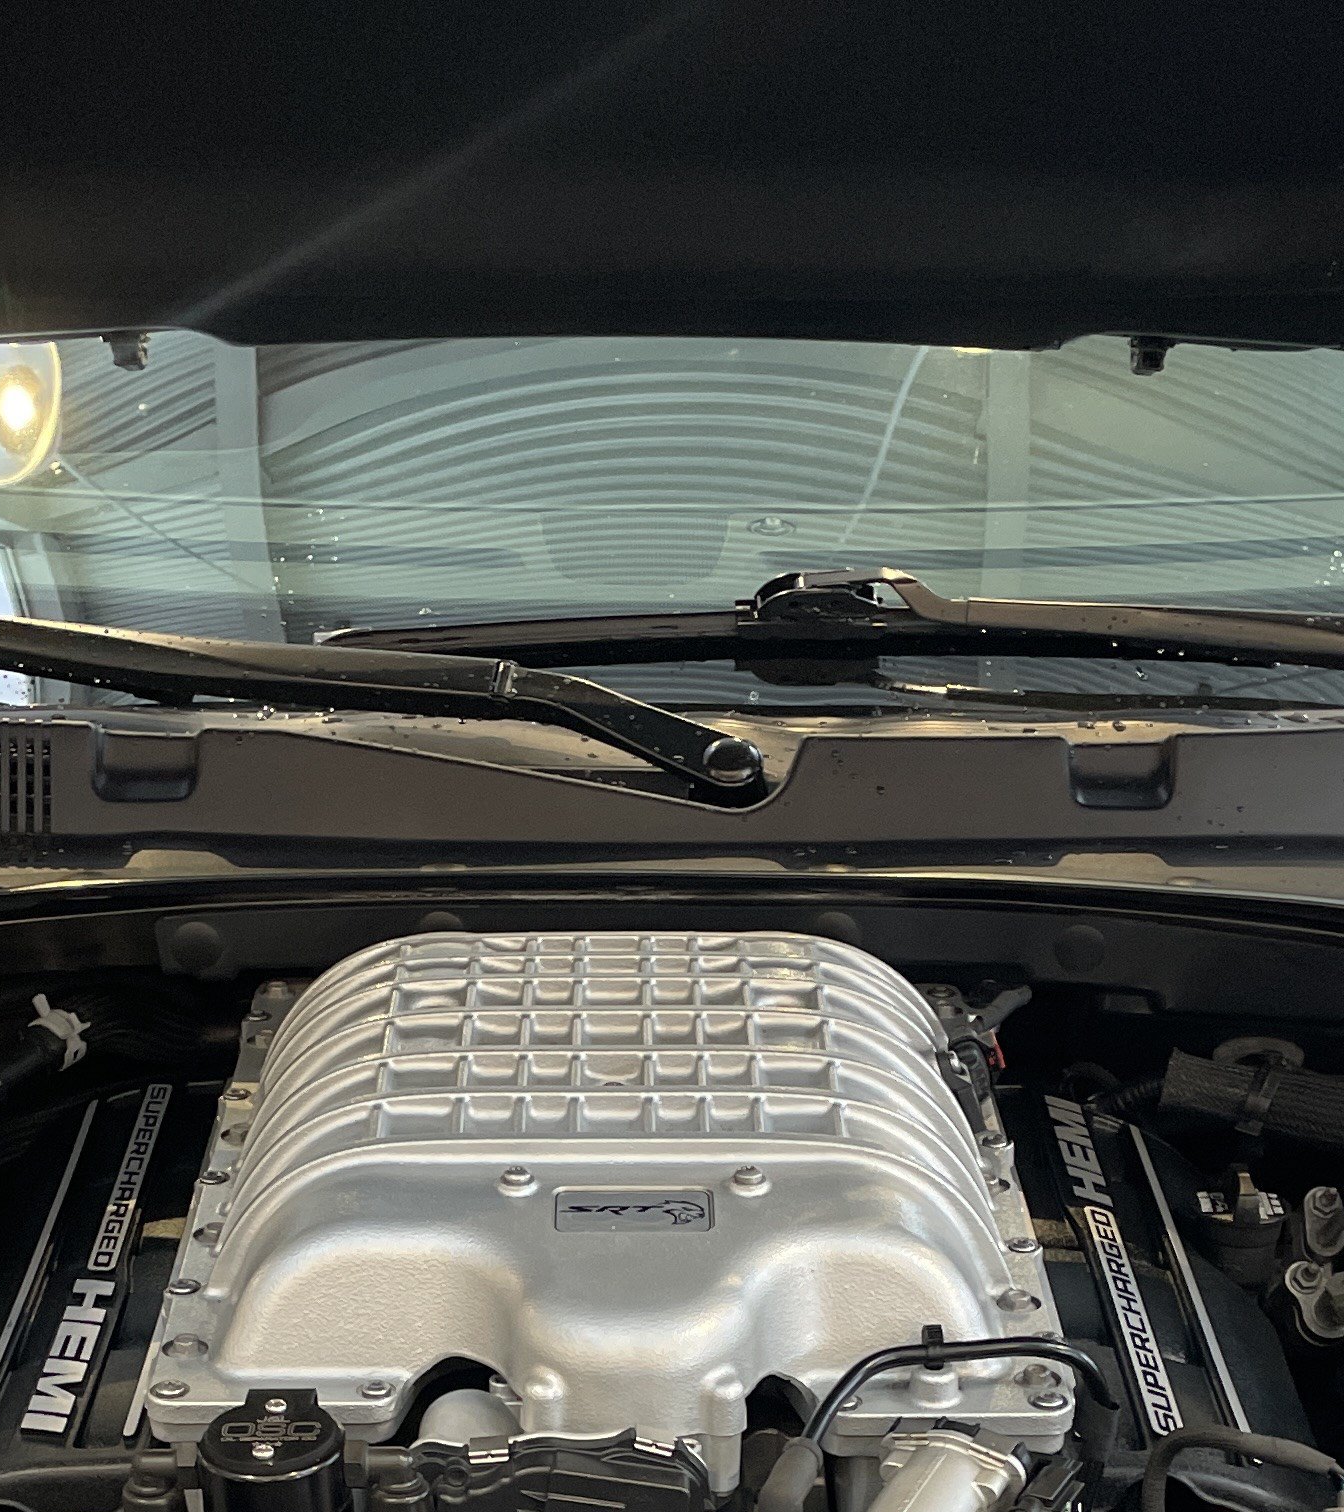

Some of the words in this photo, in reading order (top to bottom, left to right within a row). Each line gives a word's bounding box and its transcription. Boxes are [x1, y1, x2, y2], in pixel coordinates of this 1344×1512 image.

[90, 1085, 169, 1270] SUPERCHARGED
[1046, 1096, 1113, 1207] HEMI
[21, 1279, 115, 1434] HEMI
[1085, 1206, 1183, 1435] SUPERCHARGED
[221, 1421, 321, 1437] OSC
